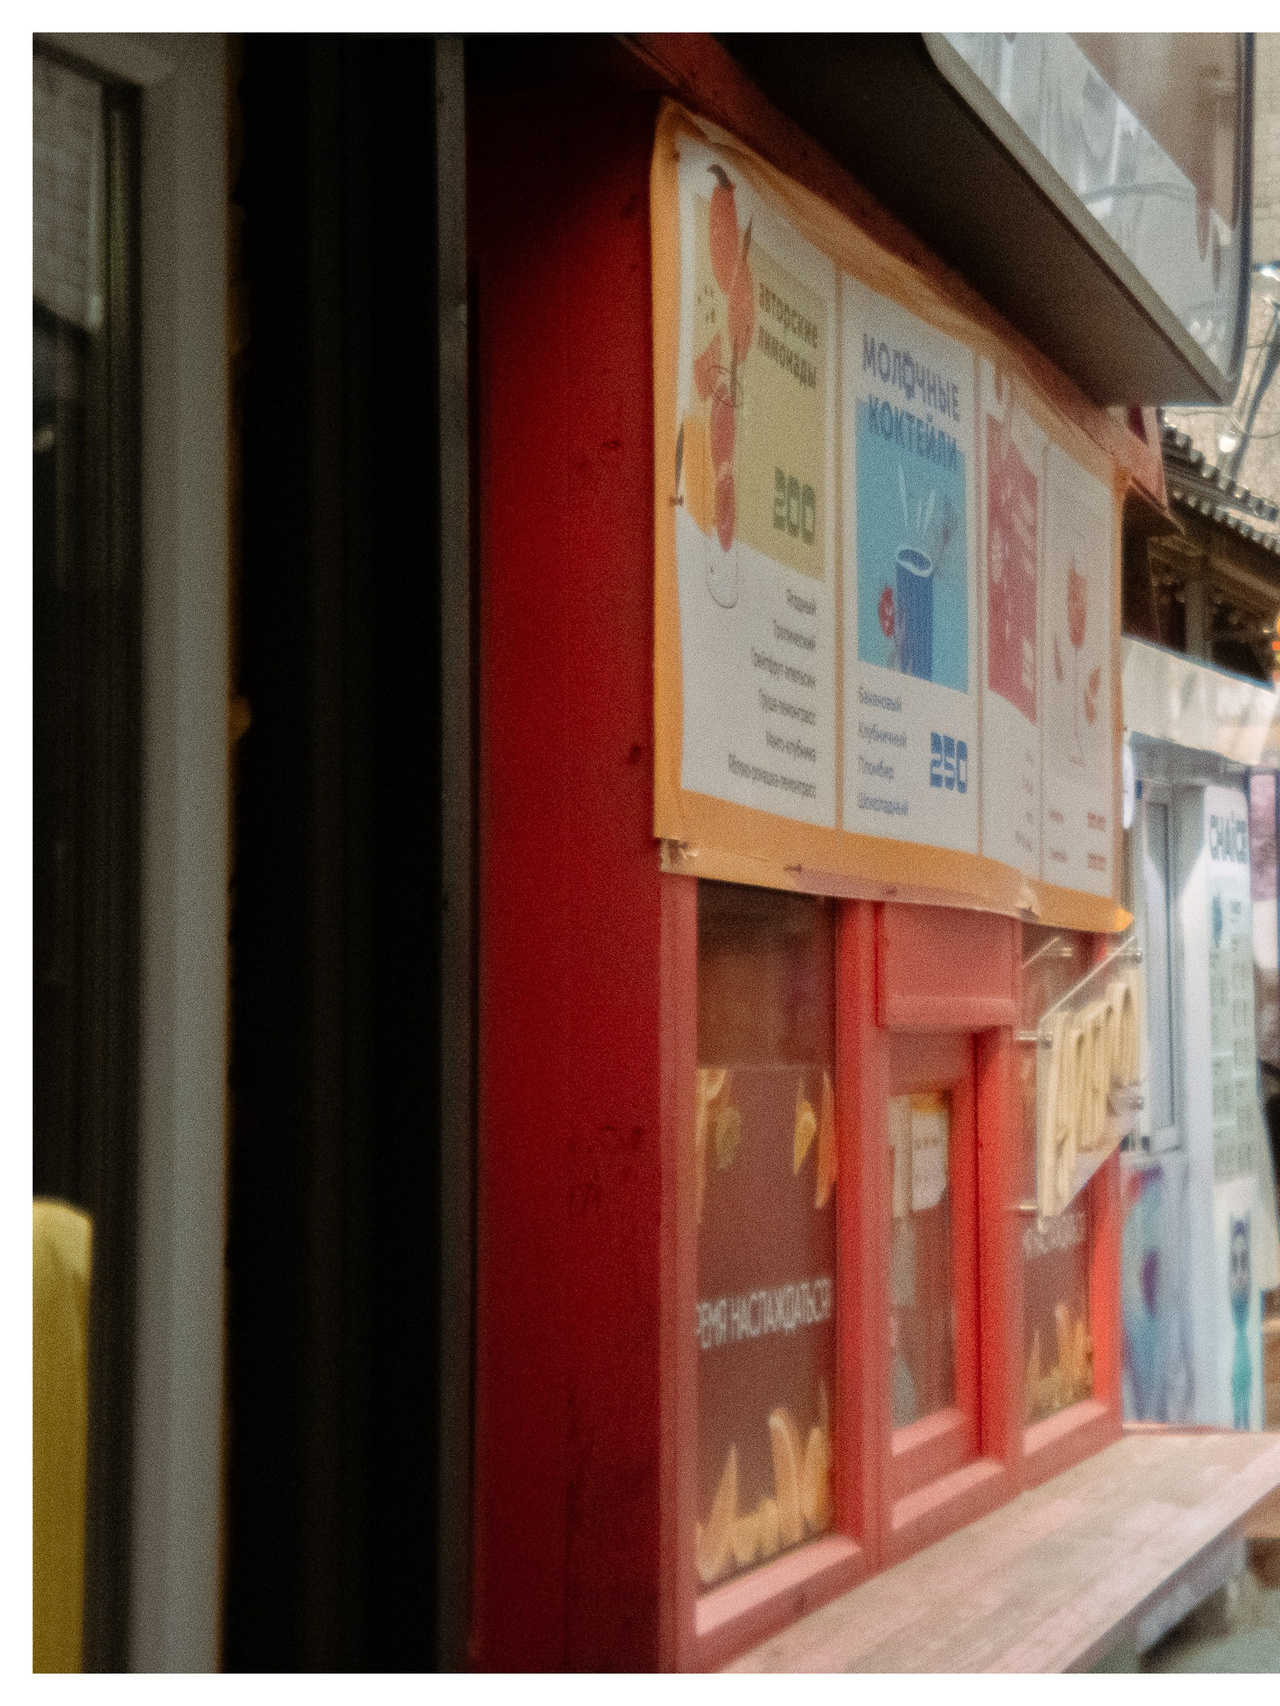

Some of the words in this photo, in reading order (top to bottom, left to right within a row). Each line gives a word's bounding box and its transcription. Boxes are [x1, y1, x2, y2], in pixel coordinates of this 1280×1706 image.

[759, 281, 818, 349] авторские
[757, 324, 817, 389] лимонады
[862, 332, 960, 422] МОЛОЧНЫЕ
[867, 394, 958, 471] КОКТЕЙЛИ
[773, 465, 816, 546] 200
[929, 731, 968, 794] 250
